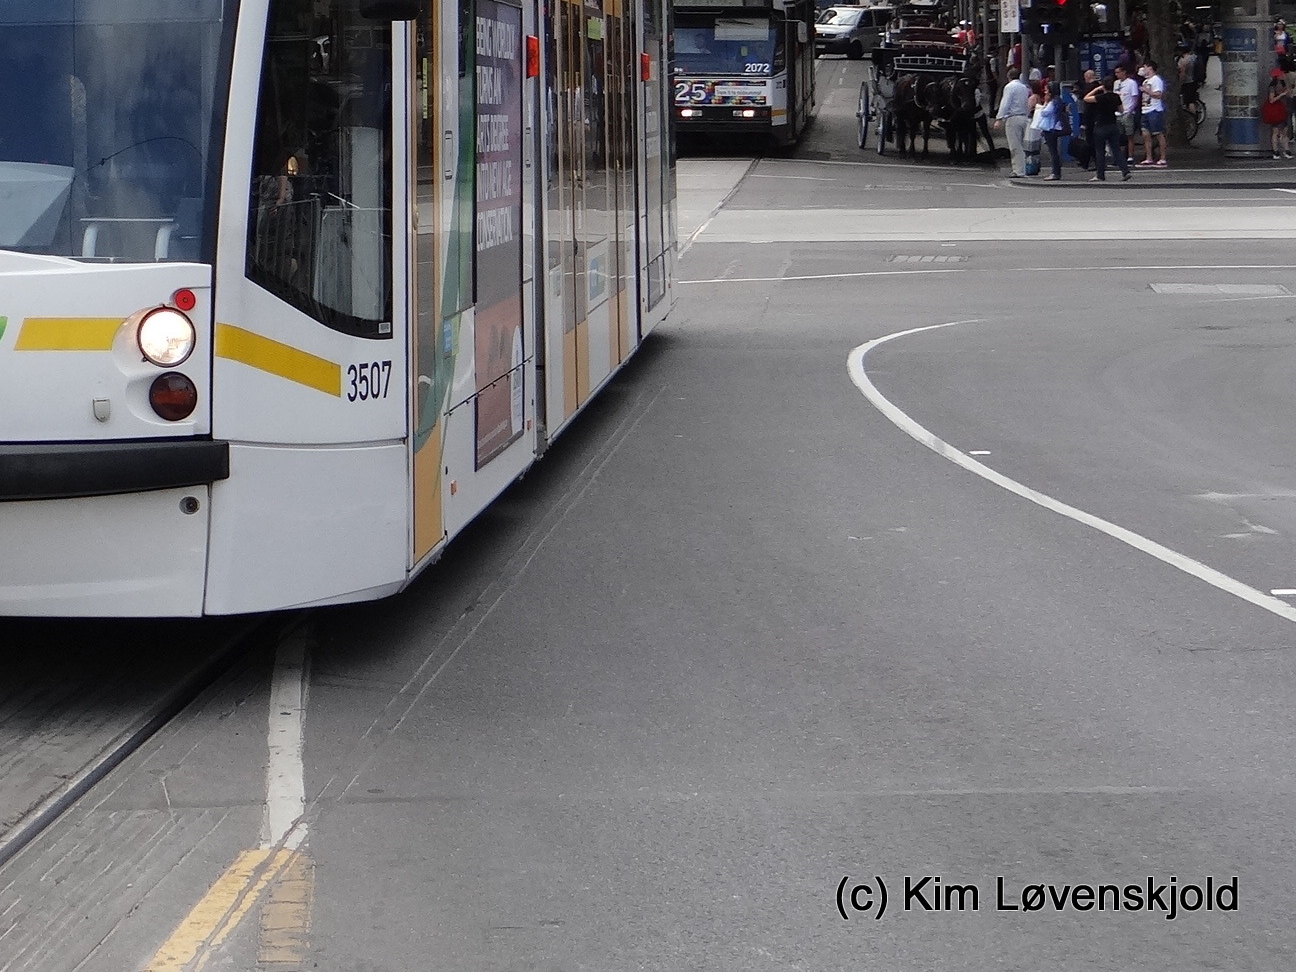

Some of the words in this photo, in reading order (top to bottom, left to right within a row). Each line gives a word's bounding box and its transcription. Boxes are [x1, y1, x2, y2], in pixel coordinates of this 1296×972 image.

[745, 63, 770, 73] 2072
[675, 83, 707, 101] 25
[347, 360, 392, 402] 3507
